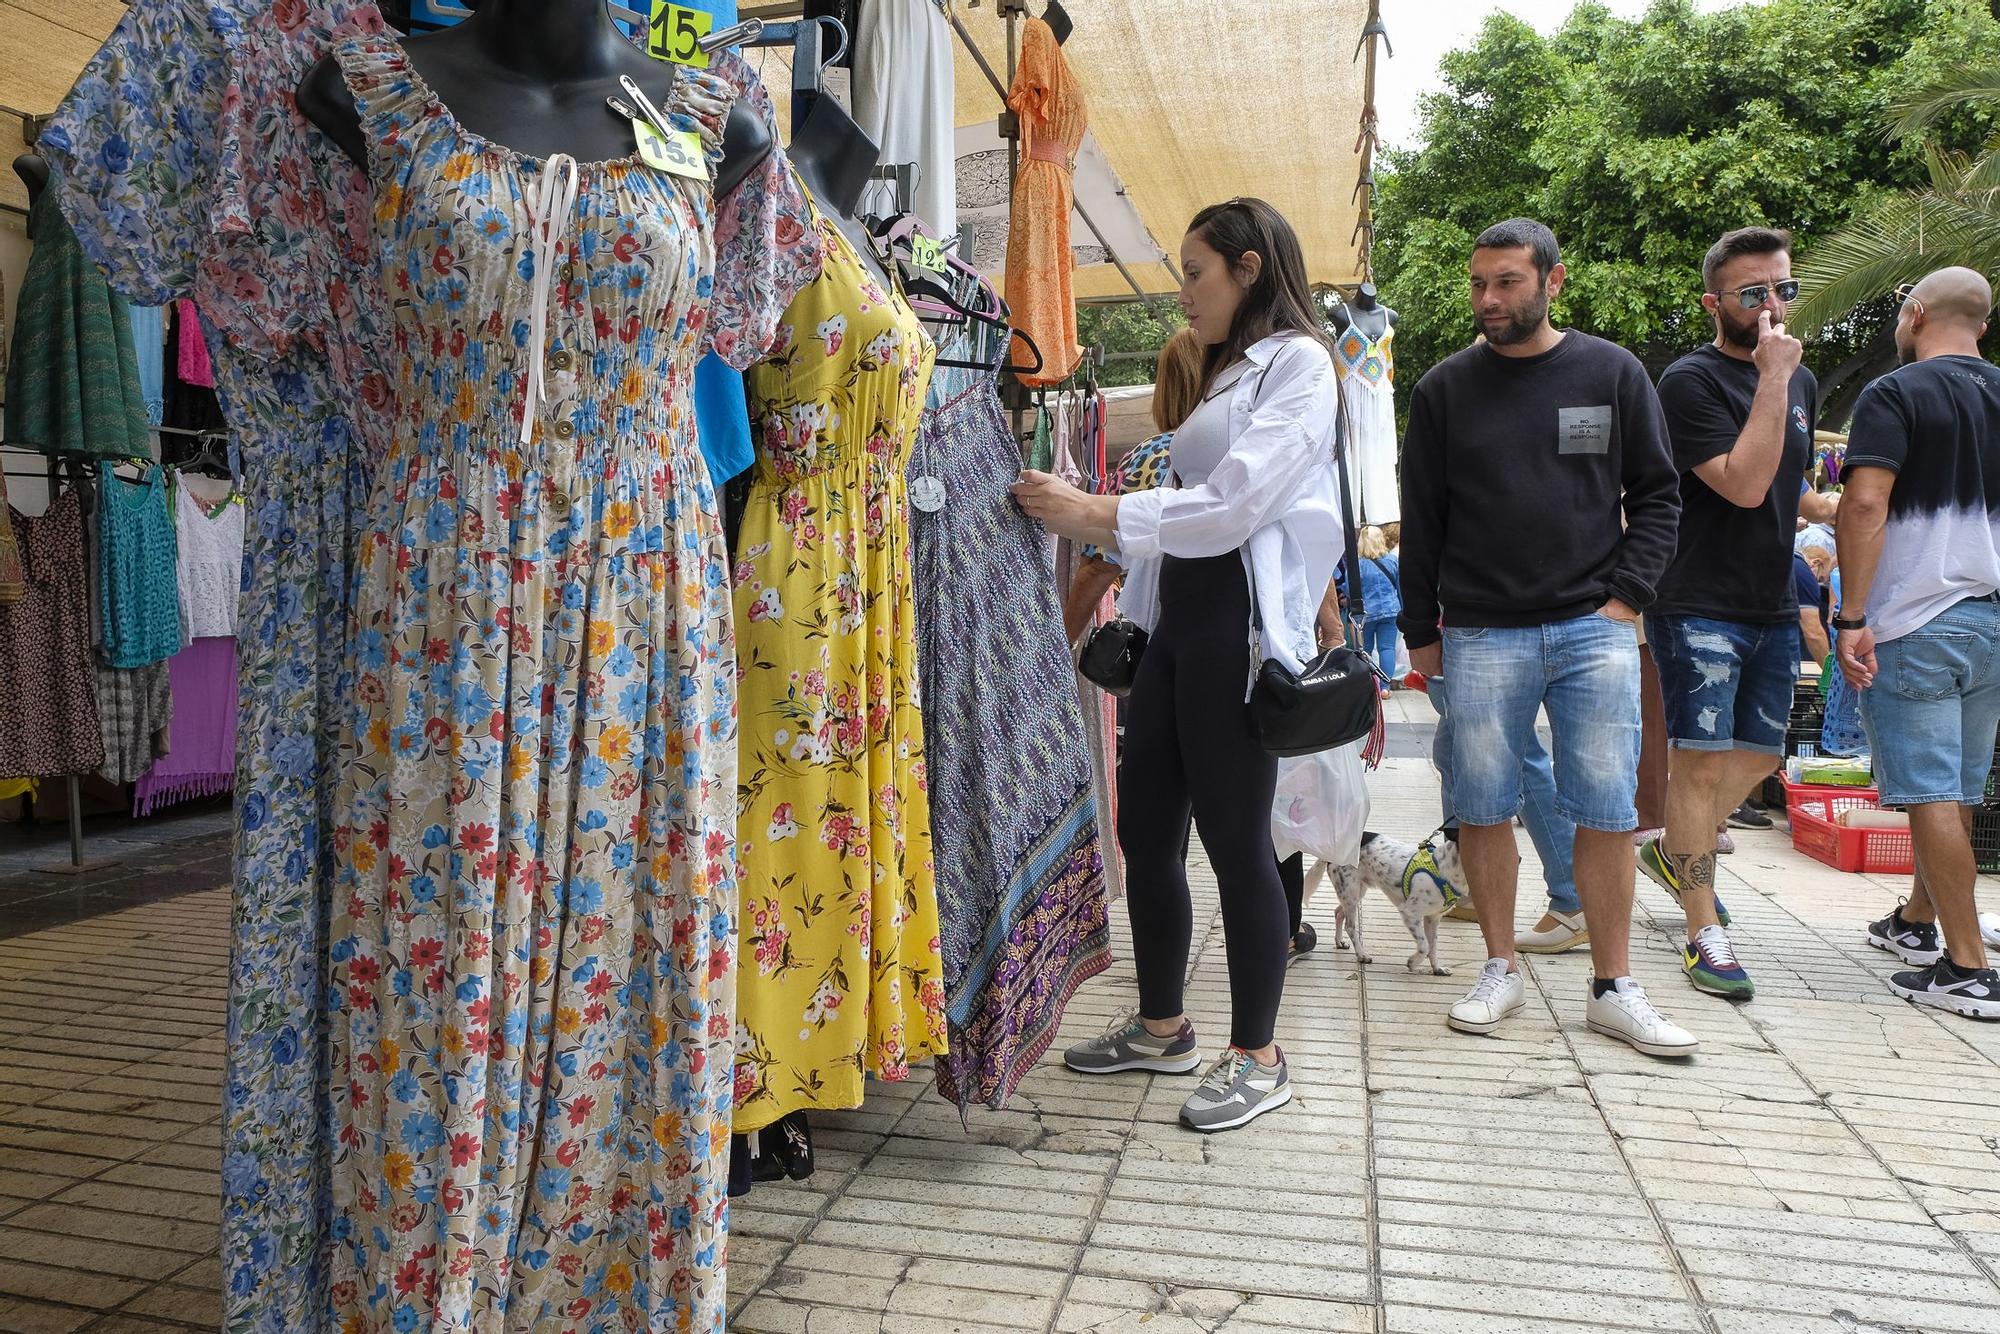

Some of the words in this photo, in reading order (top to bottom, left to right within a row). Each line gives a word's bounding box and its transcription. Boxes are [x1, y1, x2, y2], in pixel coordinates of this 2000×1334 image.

[650, 3, 711, 60] 15
[644, 135, 698, 168] 15€
[1300, 677, 1323, 687] BIMBA
[1328, 671, 1347, 681] LOLA
